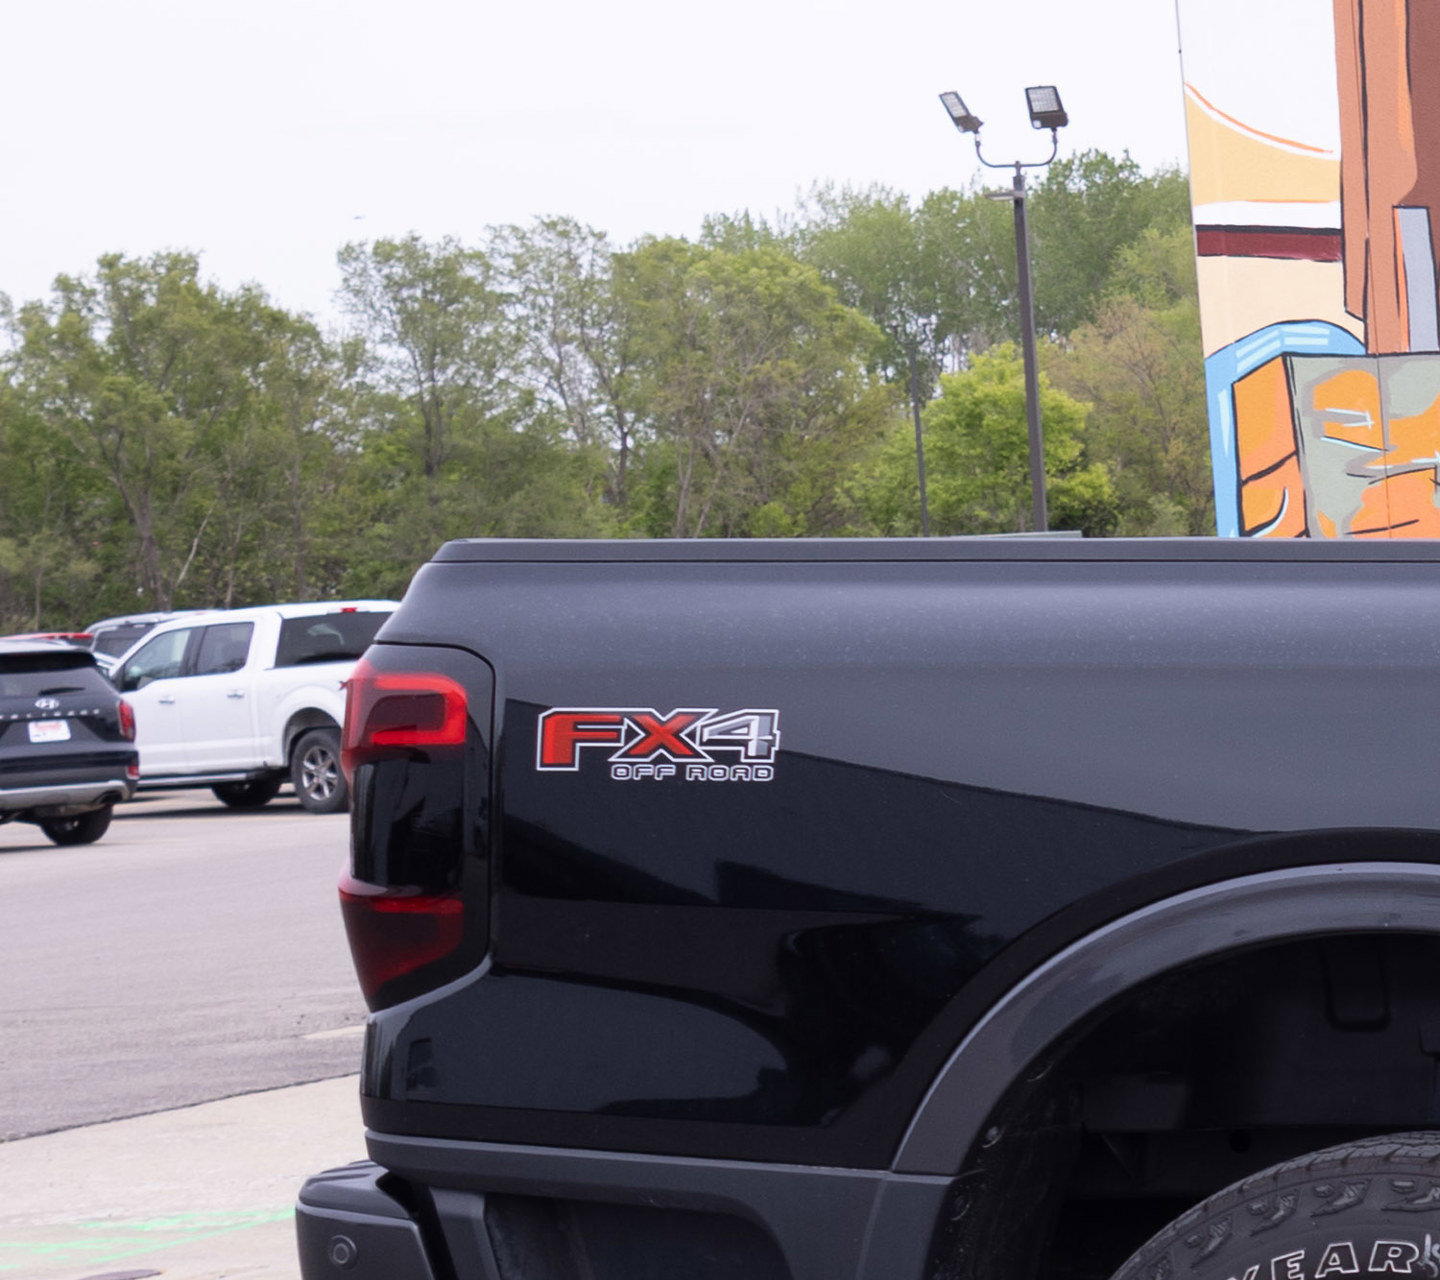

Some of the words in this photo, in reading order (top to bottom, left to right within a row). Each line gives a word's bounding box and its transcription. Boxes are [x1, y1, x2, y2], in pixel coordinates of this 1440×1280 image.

[536, 707, 780, 771] FX4
[611, 764, 676, 780] OFF
[686, 765, 774, 781] ROAD
